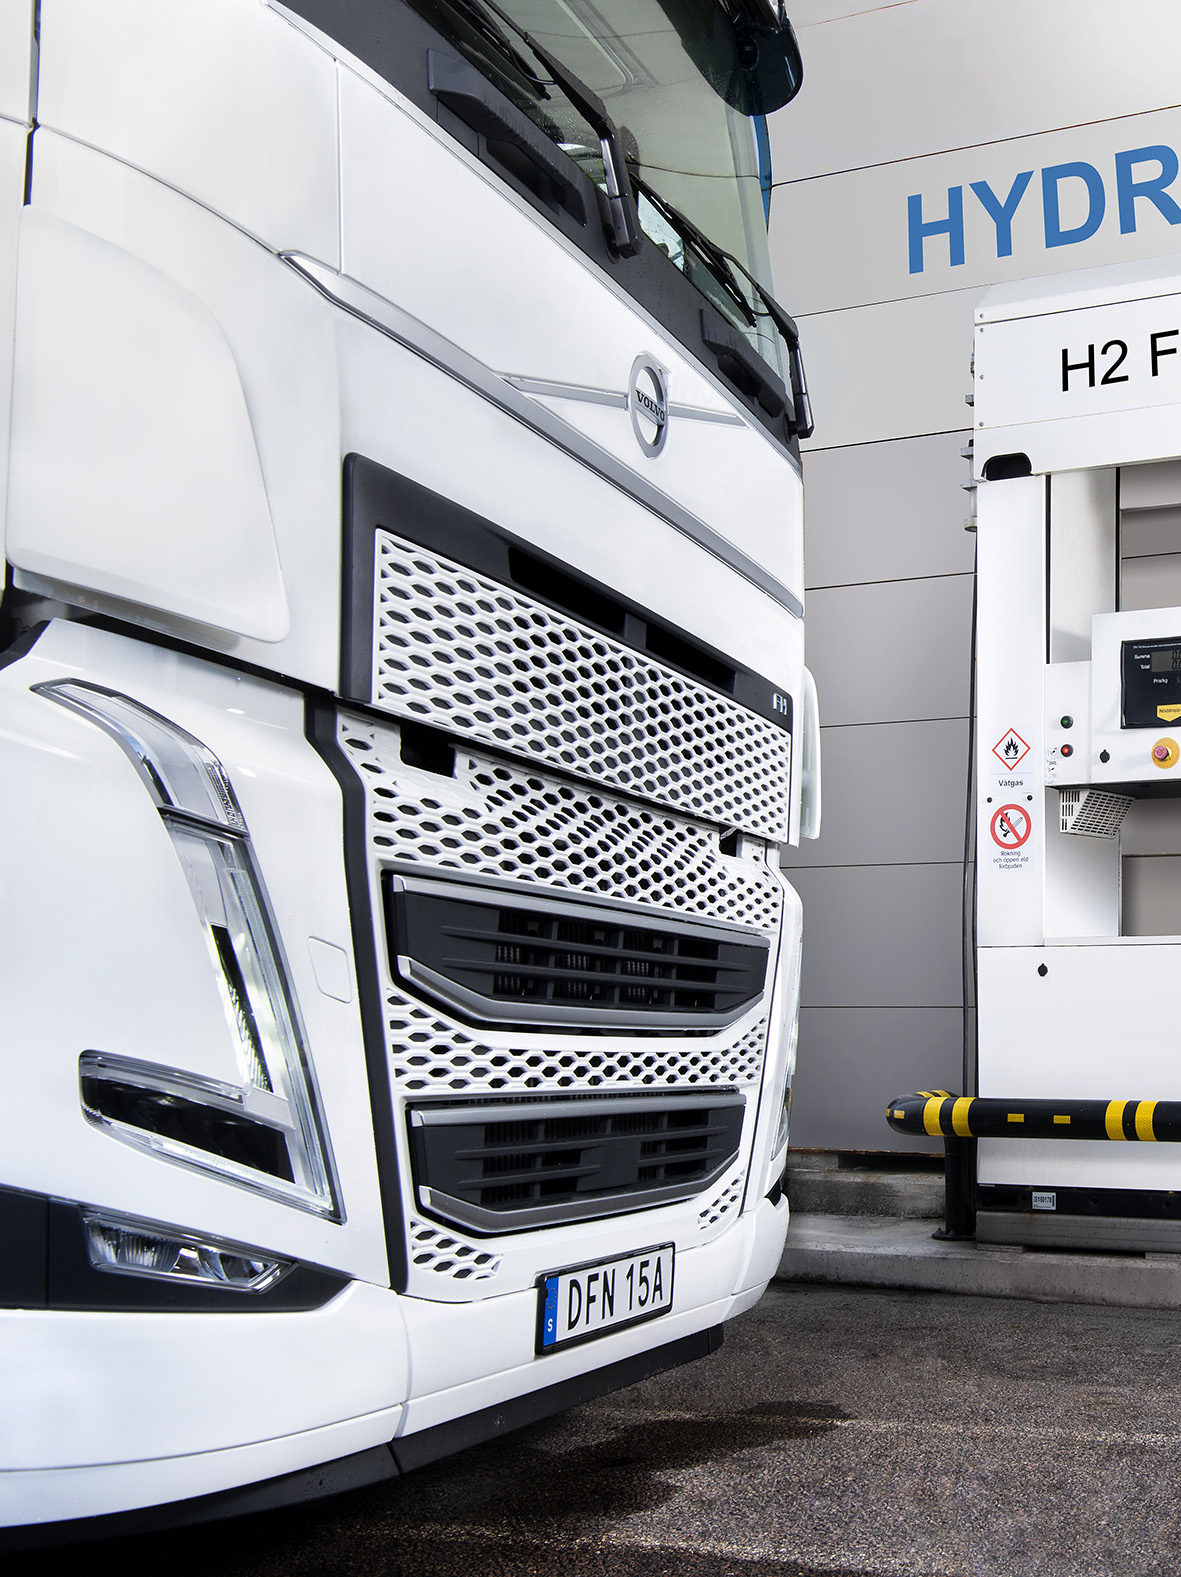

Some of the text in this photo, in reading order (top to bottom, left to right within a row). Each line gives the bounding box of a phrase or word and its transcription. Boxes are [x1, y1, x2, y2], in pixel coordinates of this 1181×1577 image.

[1061, 339, 1129, 392] H2
[635, 389, 665, 422] VOLVO
[547, 1256, 663, 1332] S DFN 15A
